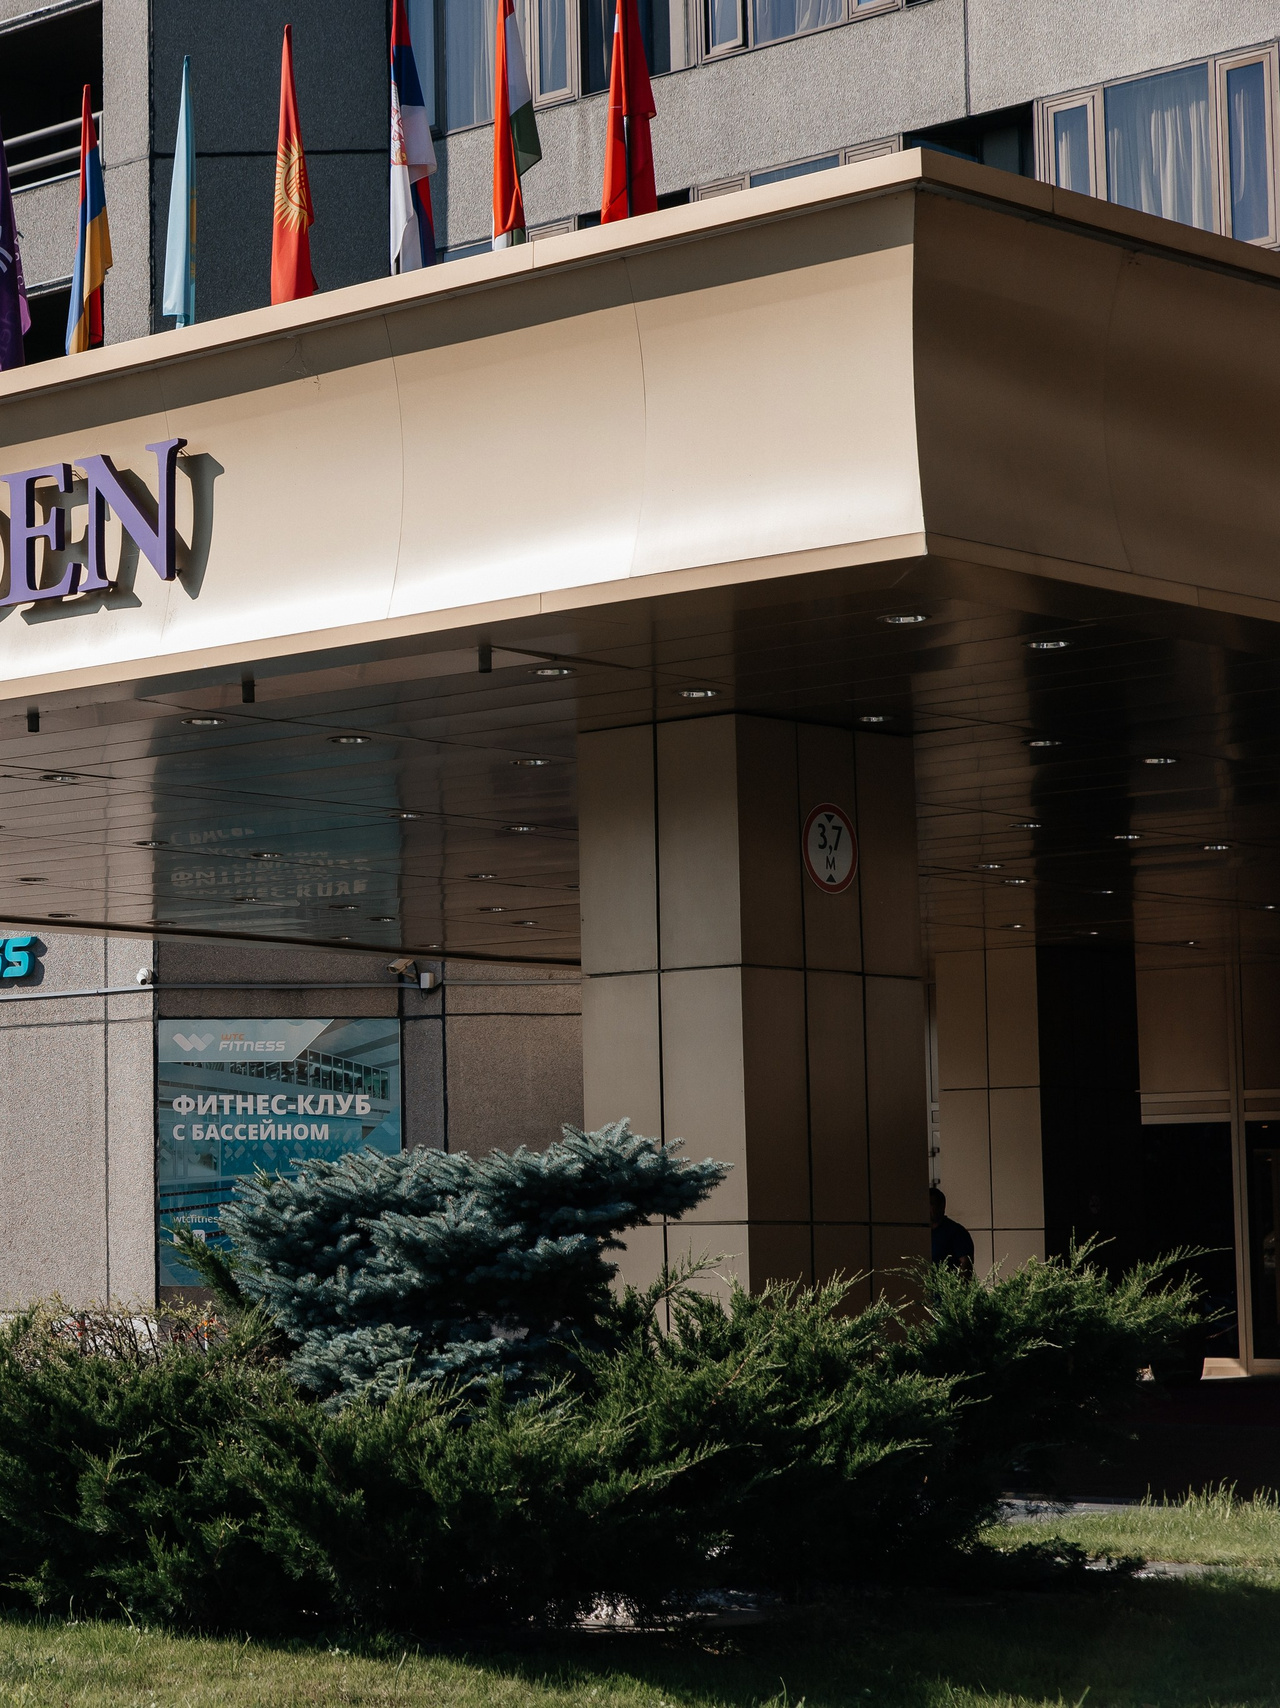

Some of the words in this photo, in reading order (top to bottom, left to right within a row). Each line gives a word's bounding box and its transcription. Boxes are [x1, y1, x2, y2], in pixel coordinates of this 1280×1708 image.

[817, 822, 843, 855] 3,7
[219, 1040, 286, 1052] FITNESS
[221, 1033, 245, 1041] WTC
[172, 1094, 371, 1116] ФИТНЕС-КЛУБ
[172, 1123, 185, 1141] С
[192, 1118, 329, 1141] БАССЕЙНОМ
